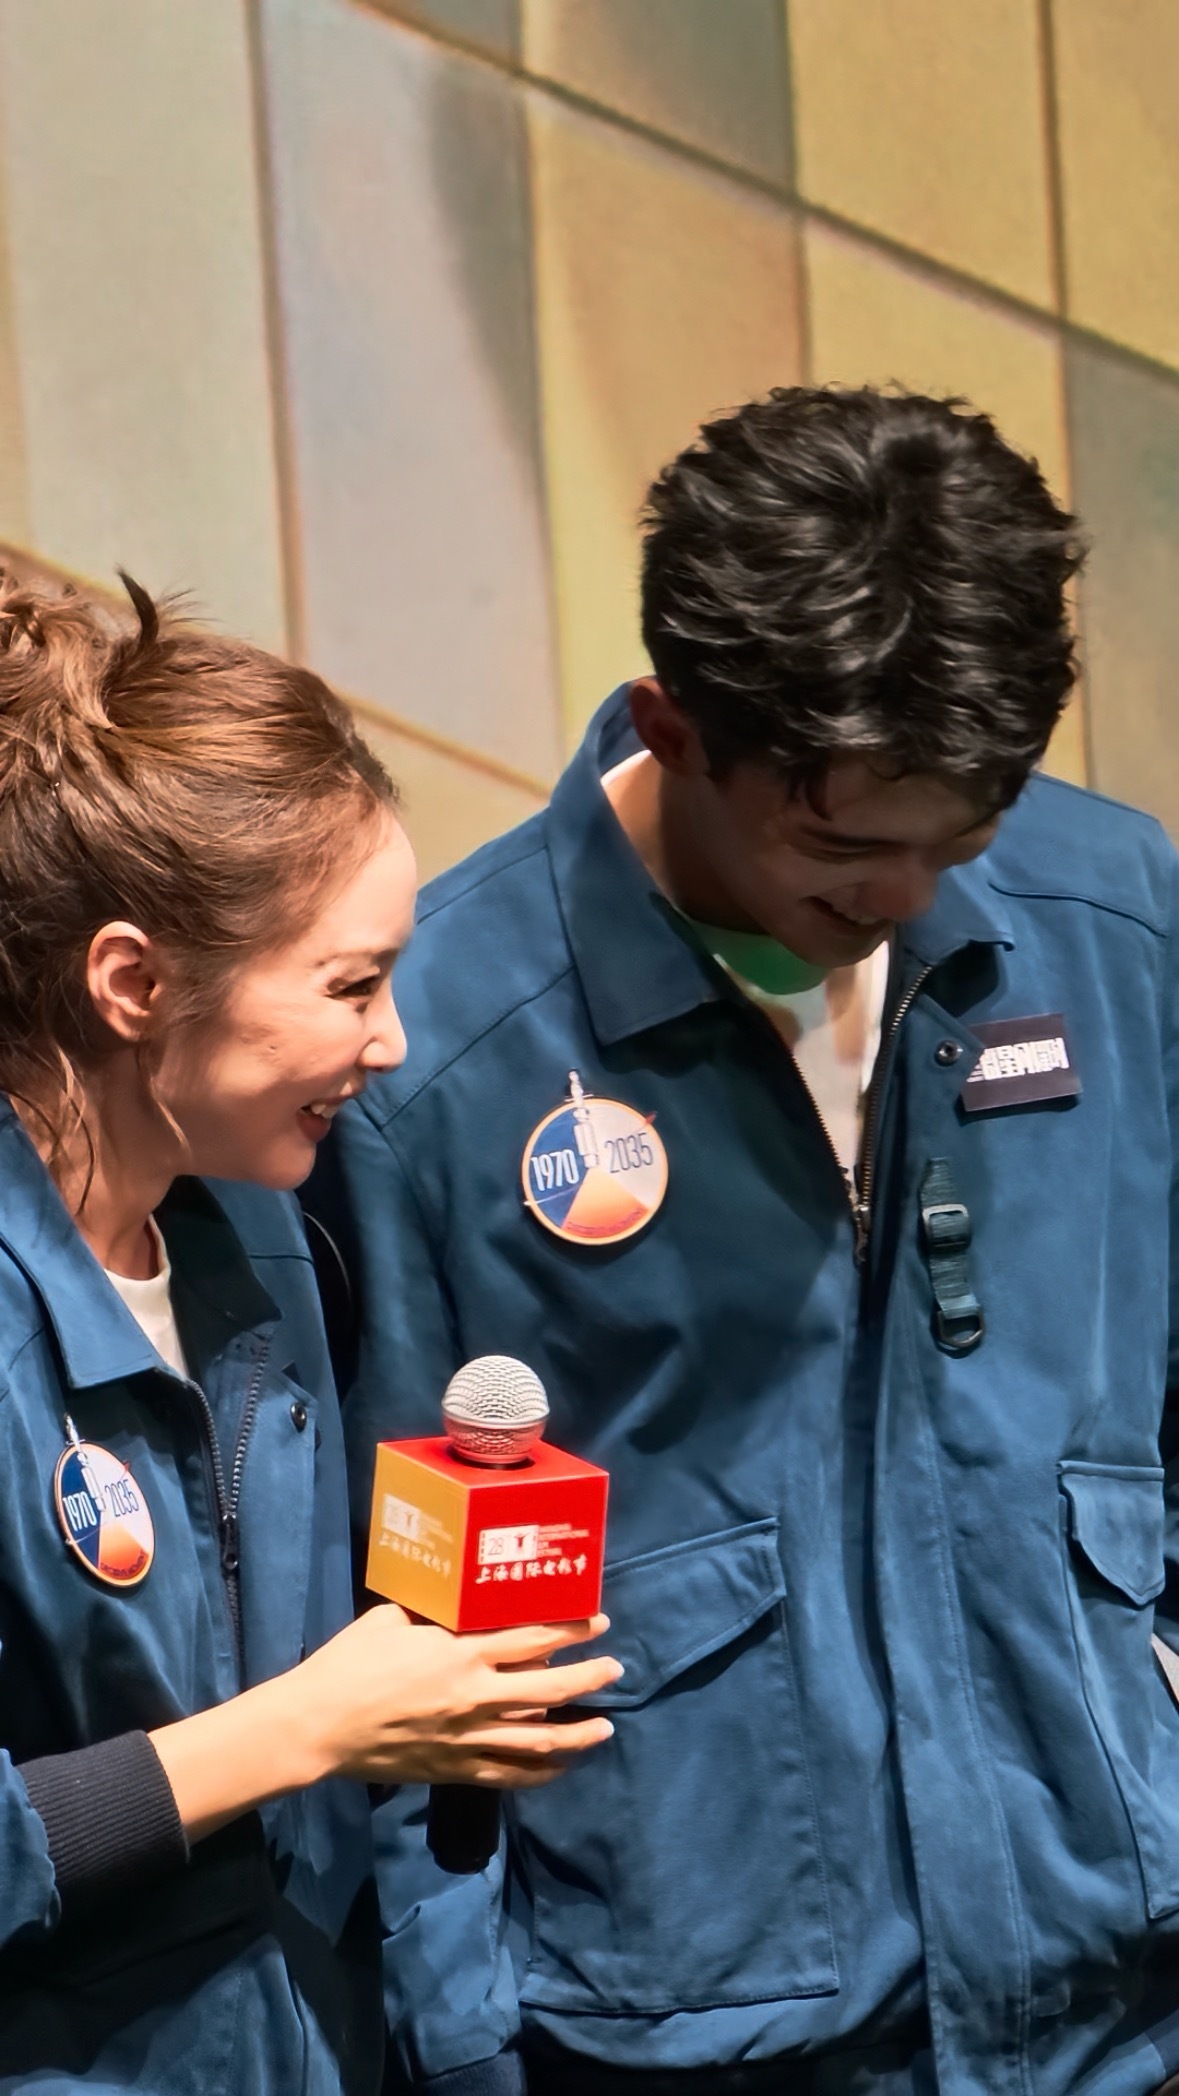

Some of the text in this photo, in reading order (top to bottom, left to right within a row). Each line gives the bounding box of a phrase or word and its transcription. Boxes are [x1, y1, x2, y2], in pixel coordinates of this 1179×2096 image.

[530, 1132, 653, 1191] 1970 2035
[62, 1479, 139, 1531] 1970 2035
